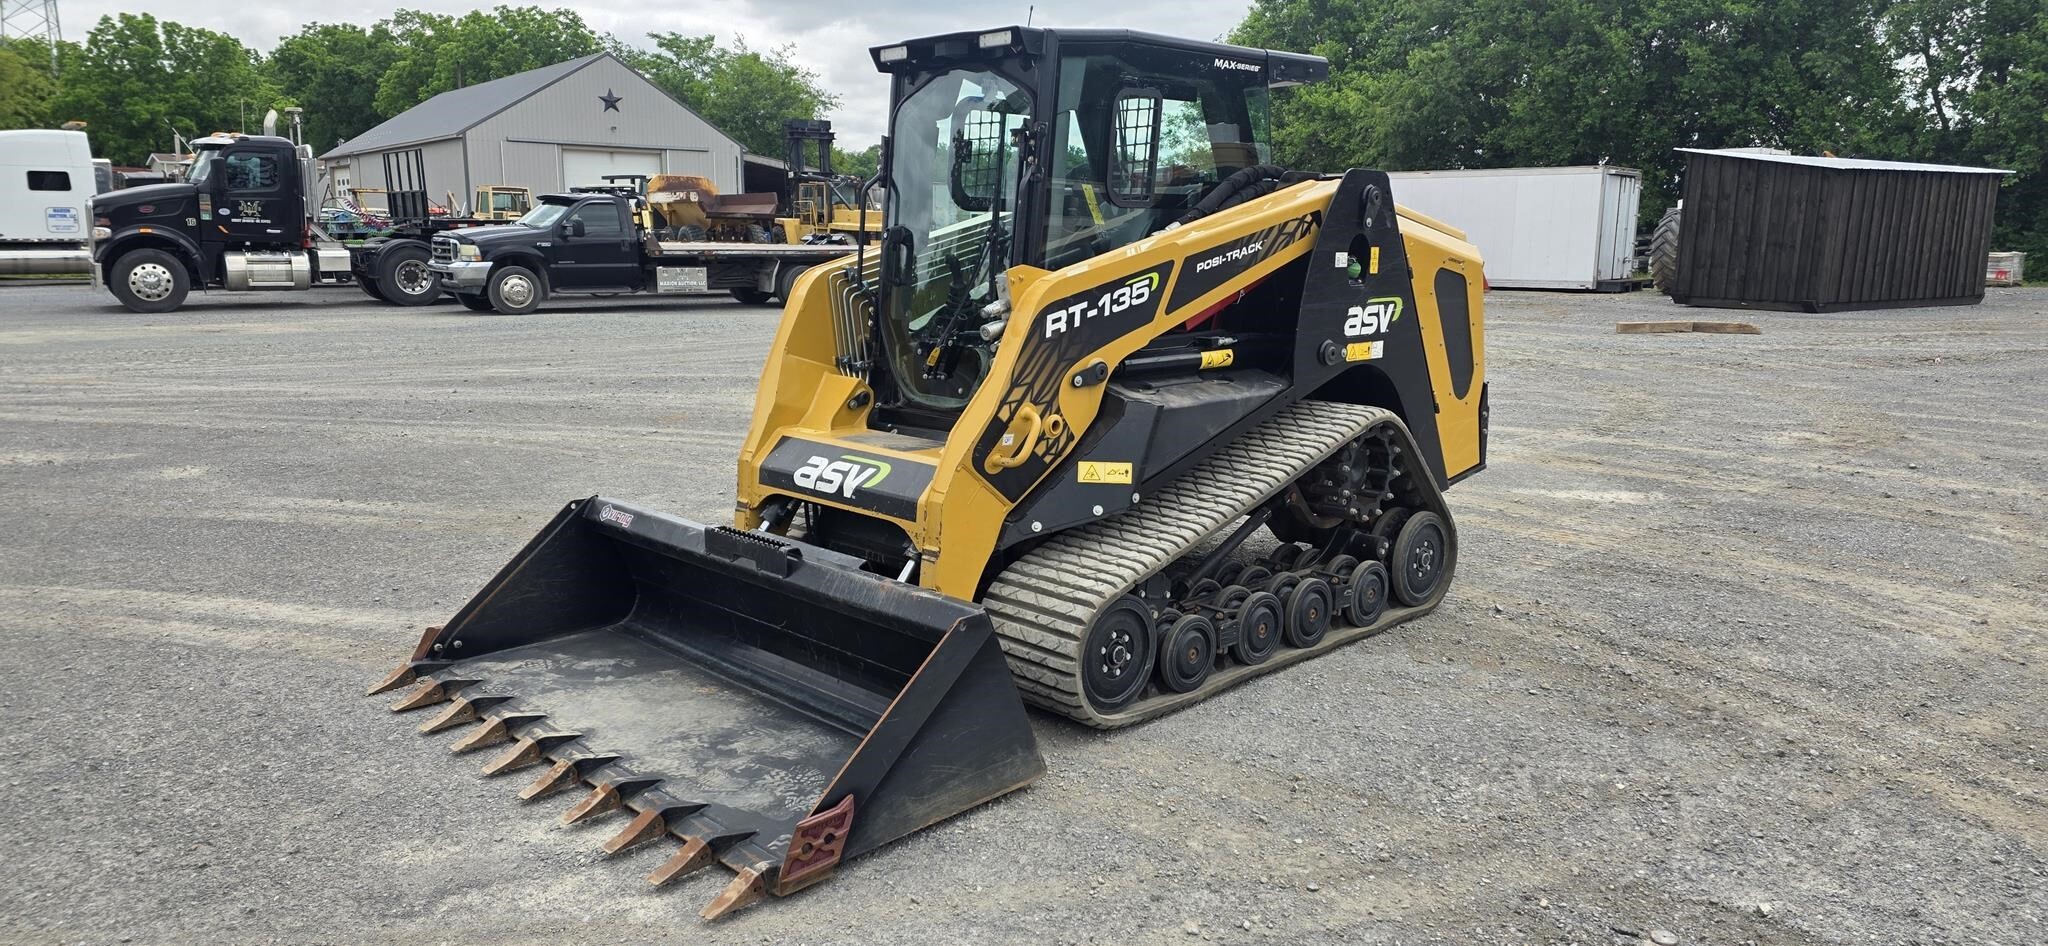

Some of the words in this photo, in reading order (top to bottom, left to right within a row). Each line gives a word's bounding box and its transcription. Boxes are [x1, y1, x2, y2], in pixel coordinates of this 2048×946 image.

[185, 217, 197, 226] 16
[1196, 240, 1263, 273] POSI-TRACK
[1045, 279, 1150, 339] RT-135
